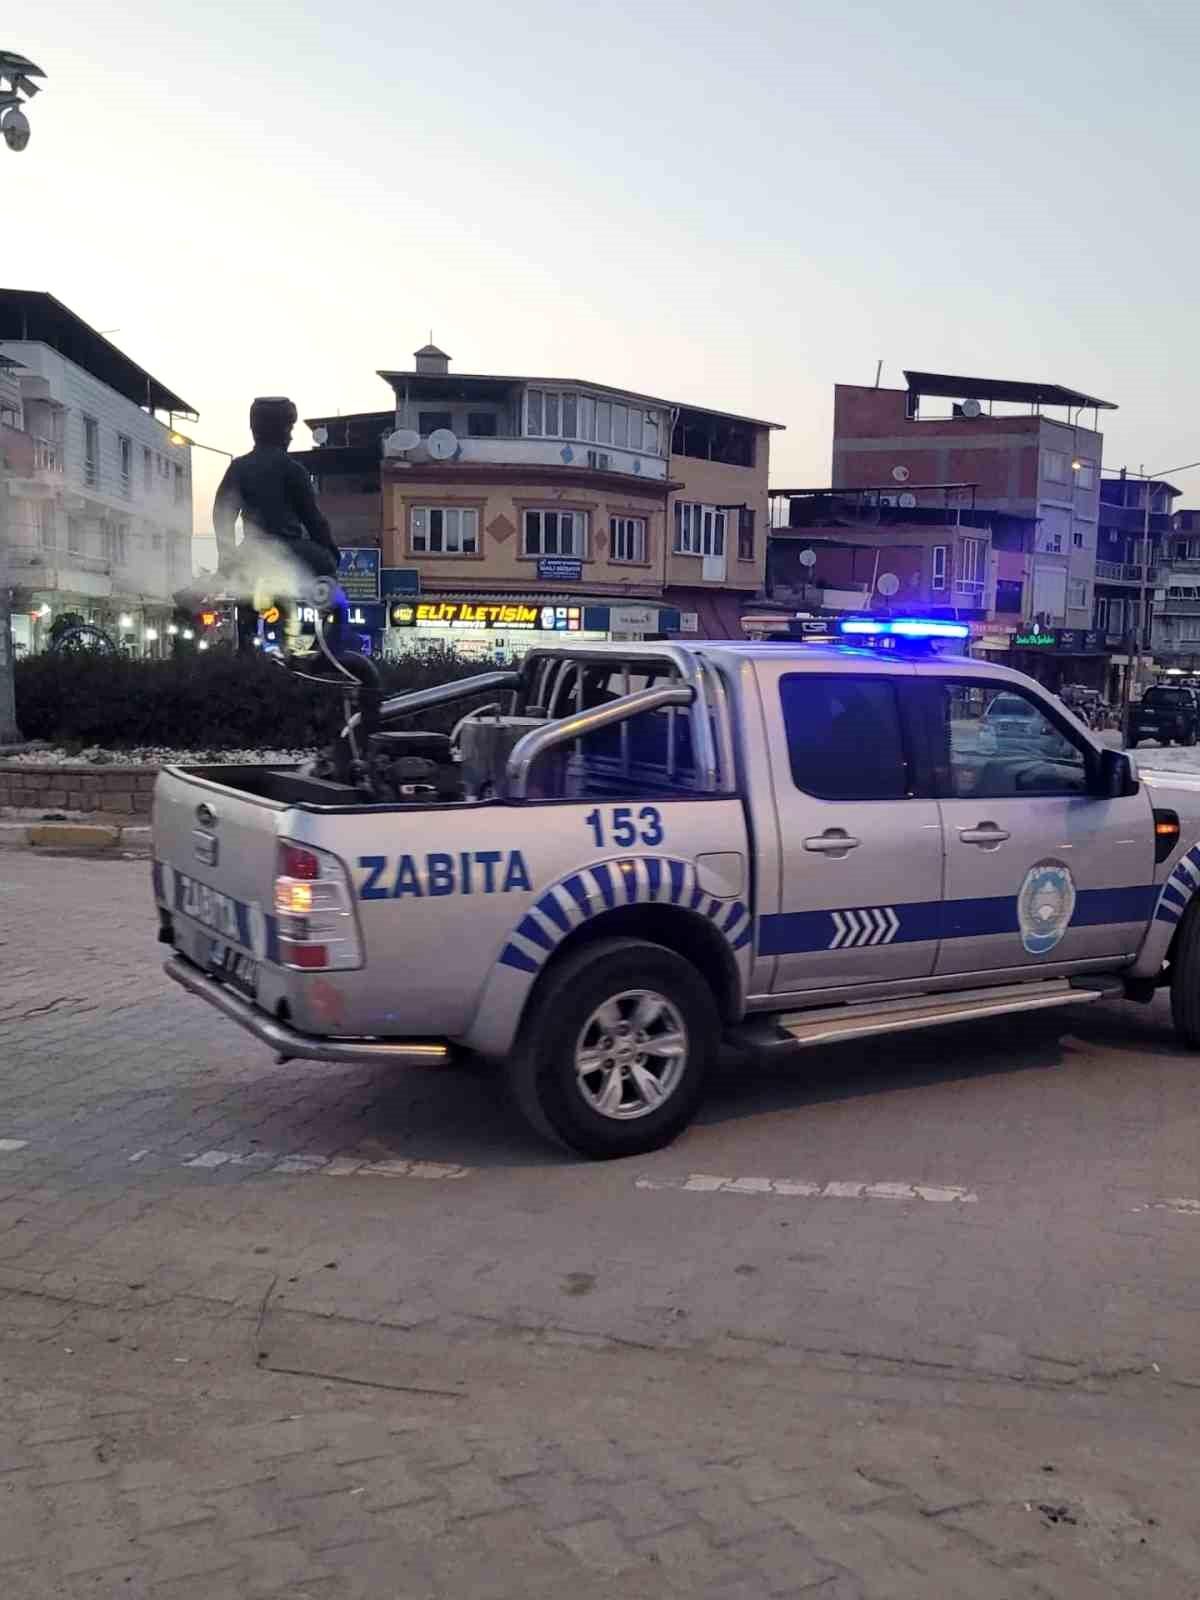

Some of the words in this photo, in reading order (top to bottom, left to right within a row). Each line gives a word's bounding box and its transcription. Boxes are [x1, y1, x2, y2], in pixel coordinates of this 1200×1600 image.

[416, 603, 457, 621] ELİT
[584, 806, 663, 847] 153
[358, 850, 533, 900] ZABITA
